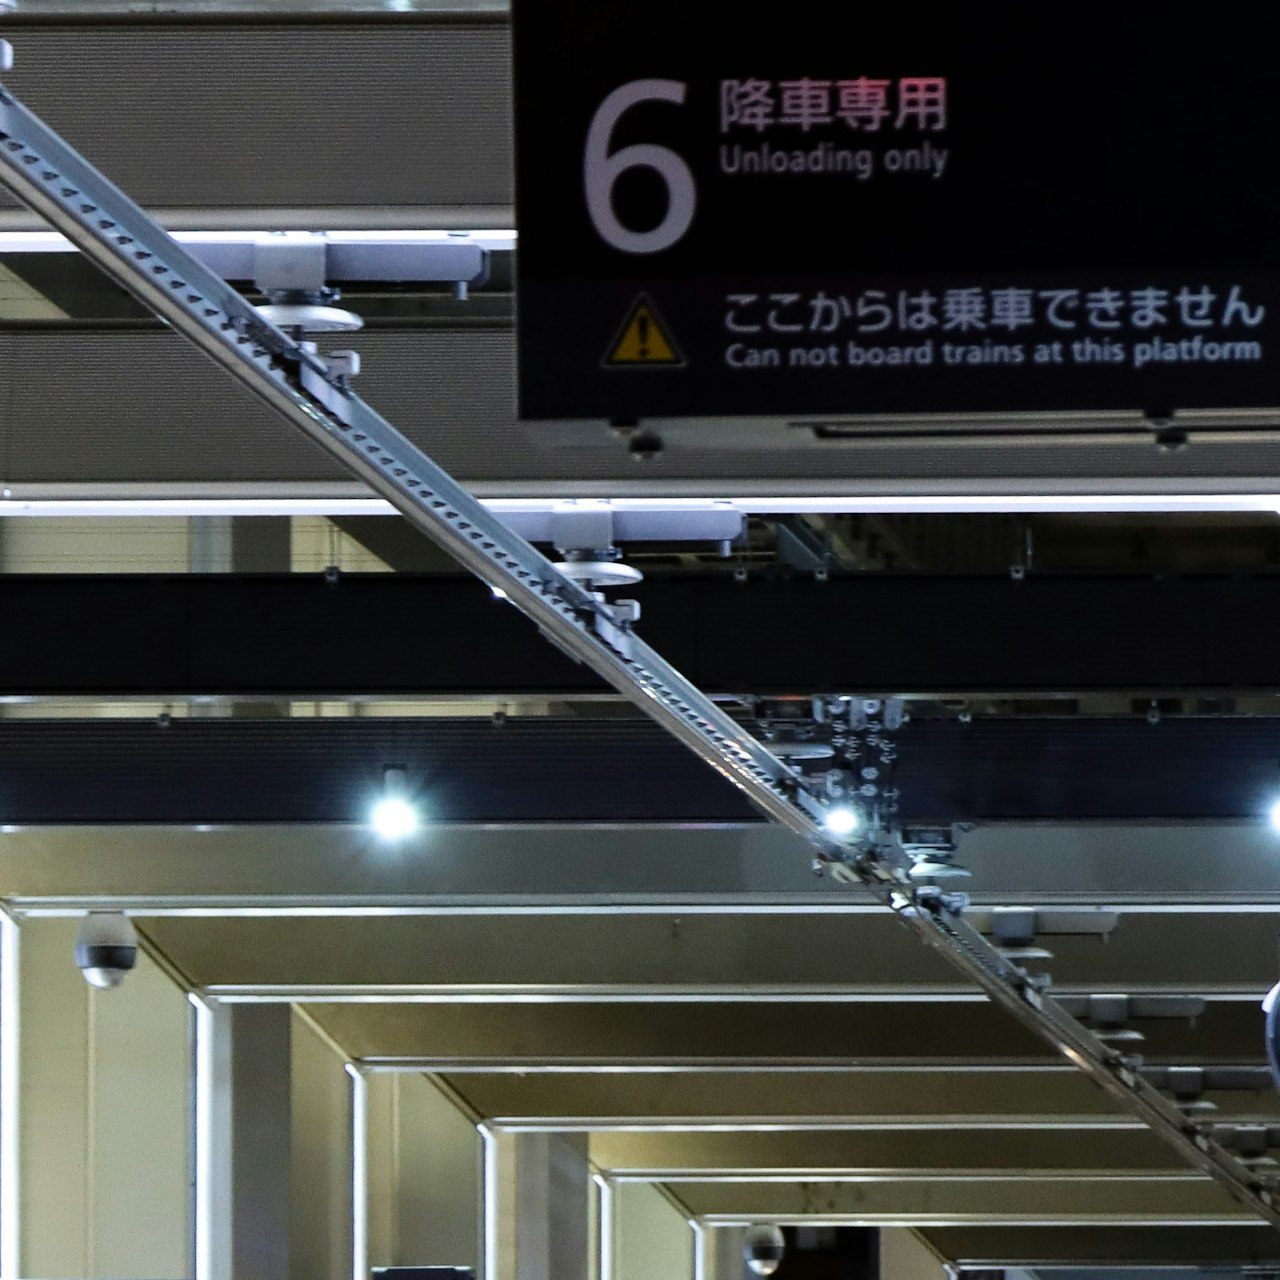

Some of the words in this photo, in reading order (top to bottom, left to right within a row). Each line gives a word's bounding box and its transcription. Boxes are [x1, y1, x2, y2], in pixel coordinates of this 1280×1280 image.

[720, 77, 947, 132] 降車専用
[583, 79, 696, 254] 6
[720, 144, 872, 178] Unloading
[884, 147, 948, 178] only
[724, 286, 1265, 332] ここからは乗車できません
[725, 343, 780, 367] Can
[790, 345, 838, 366] not
[848, 340, 933, 366] board
[942, 341, 1025, 365] trains
[1033, 341, 1063, 363] at
[1071, 336, 1126, 362] this
[1134, 335, 1262, 368] platform
